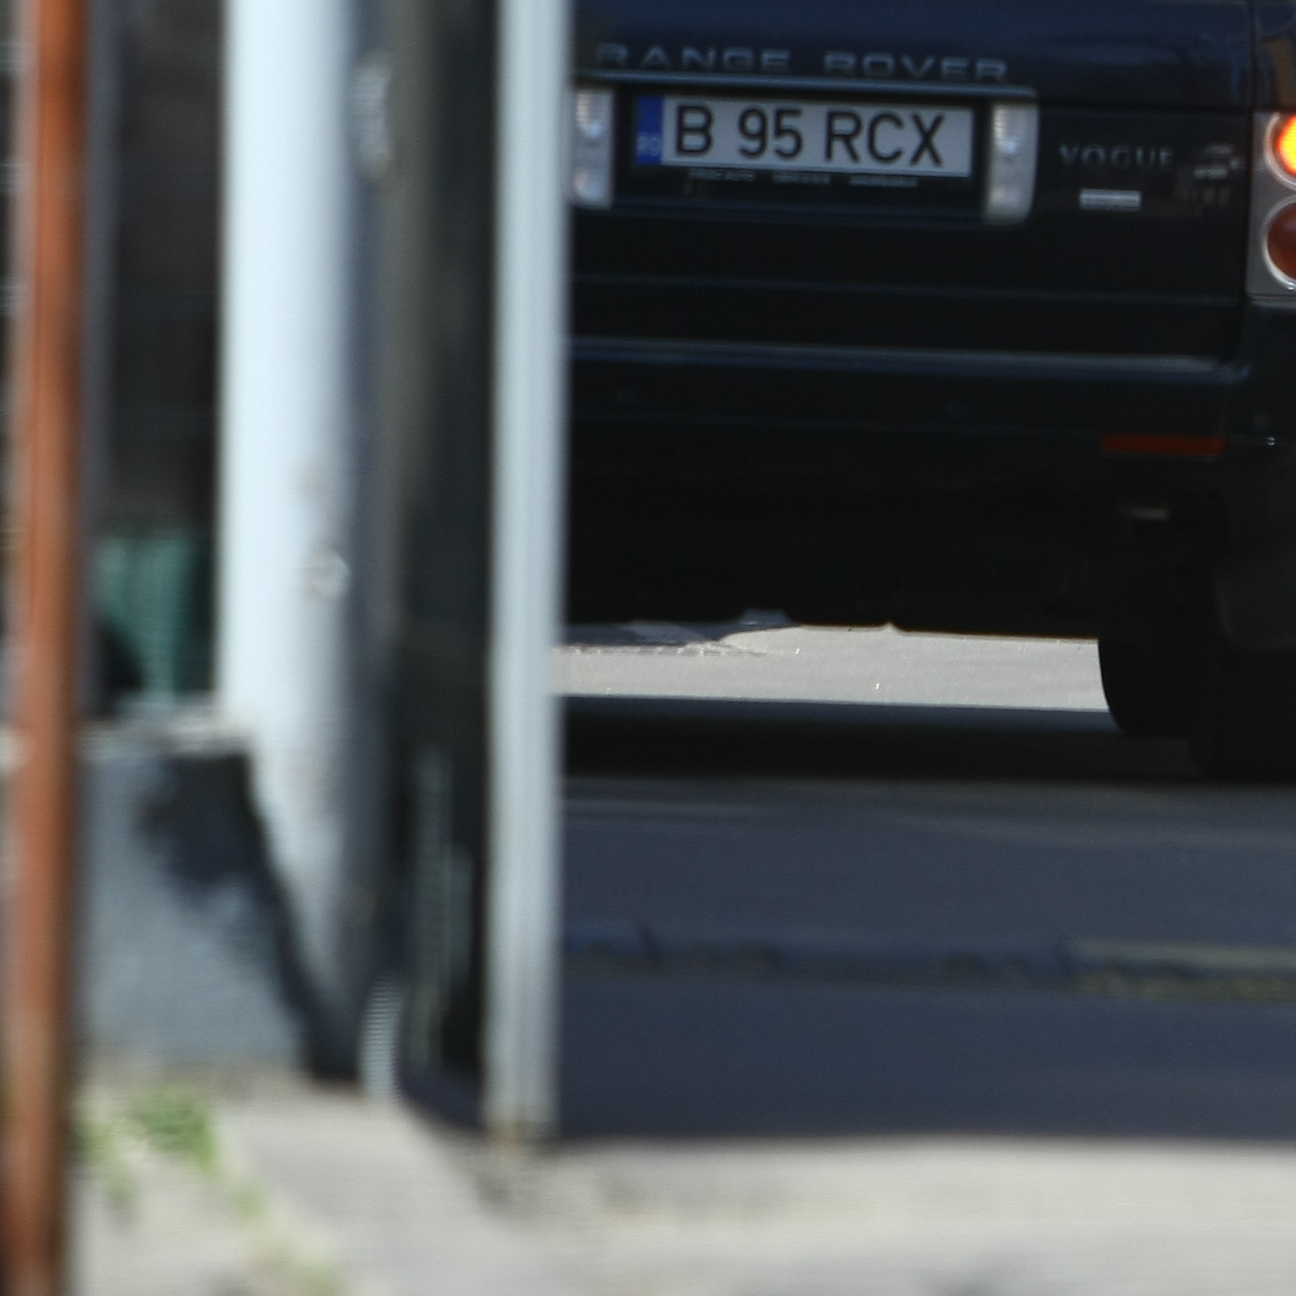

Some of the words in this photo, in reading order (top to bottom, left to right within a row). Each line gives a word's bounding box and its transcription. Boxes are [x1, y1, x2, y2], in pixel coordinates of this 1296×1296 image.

[595, 42, 792, 74] RANGE
[822, 49, 1010, 83] ROVER
[676, 105, 713, 156] B
[737, 108, 803, 159] 95
[823, 110, 944, 167] RCX
[1057, 143, 1174, 170] VOGUE
